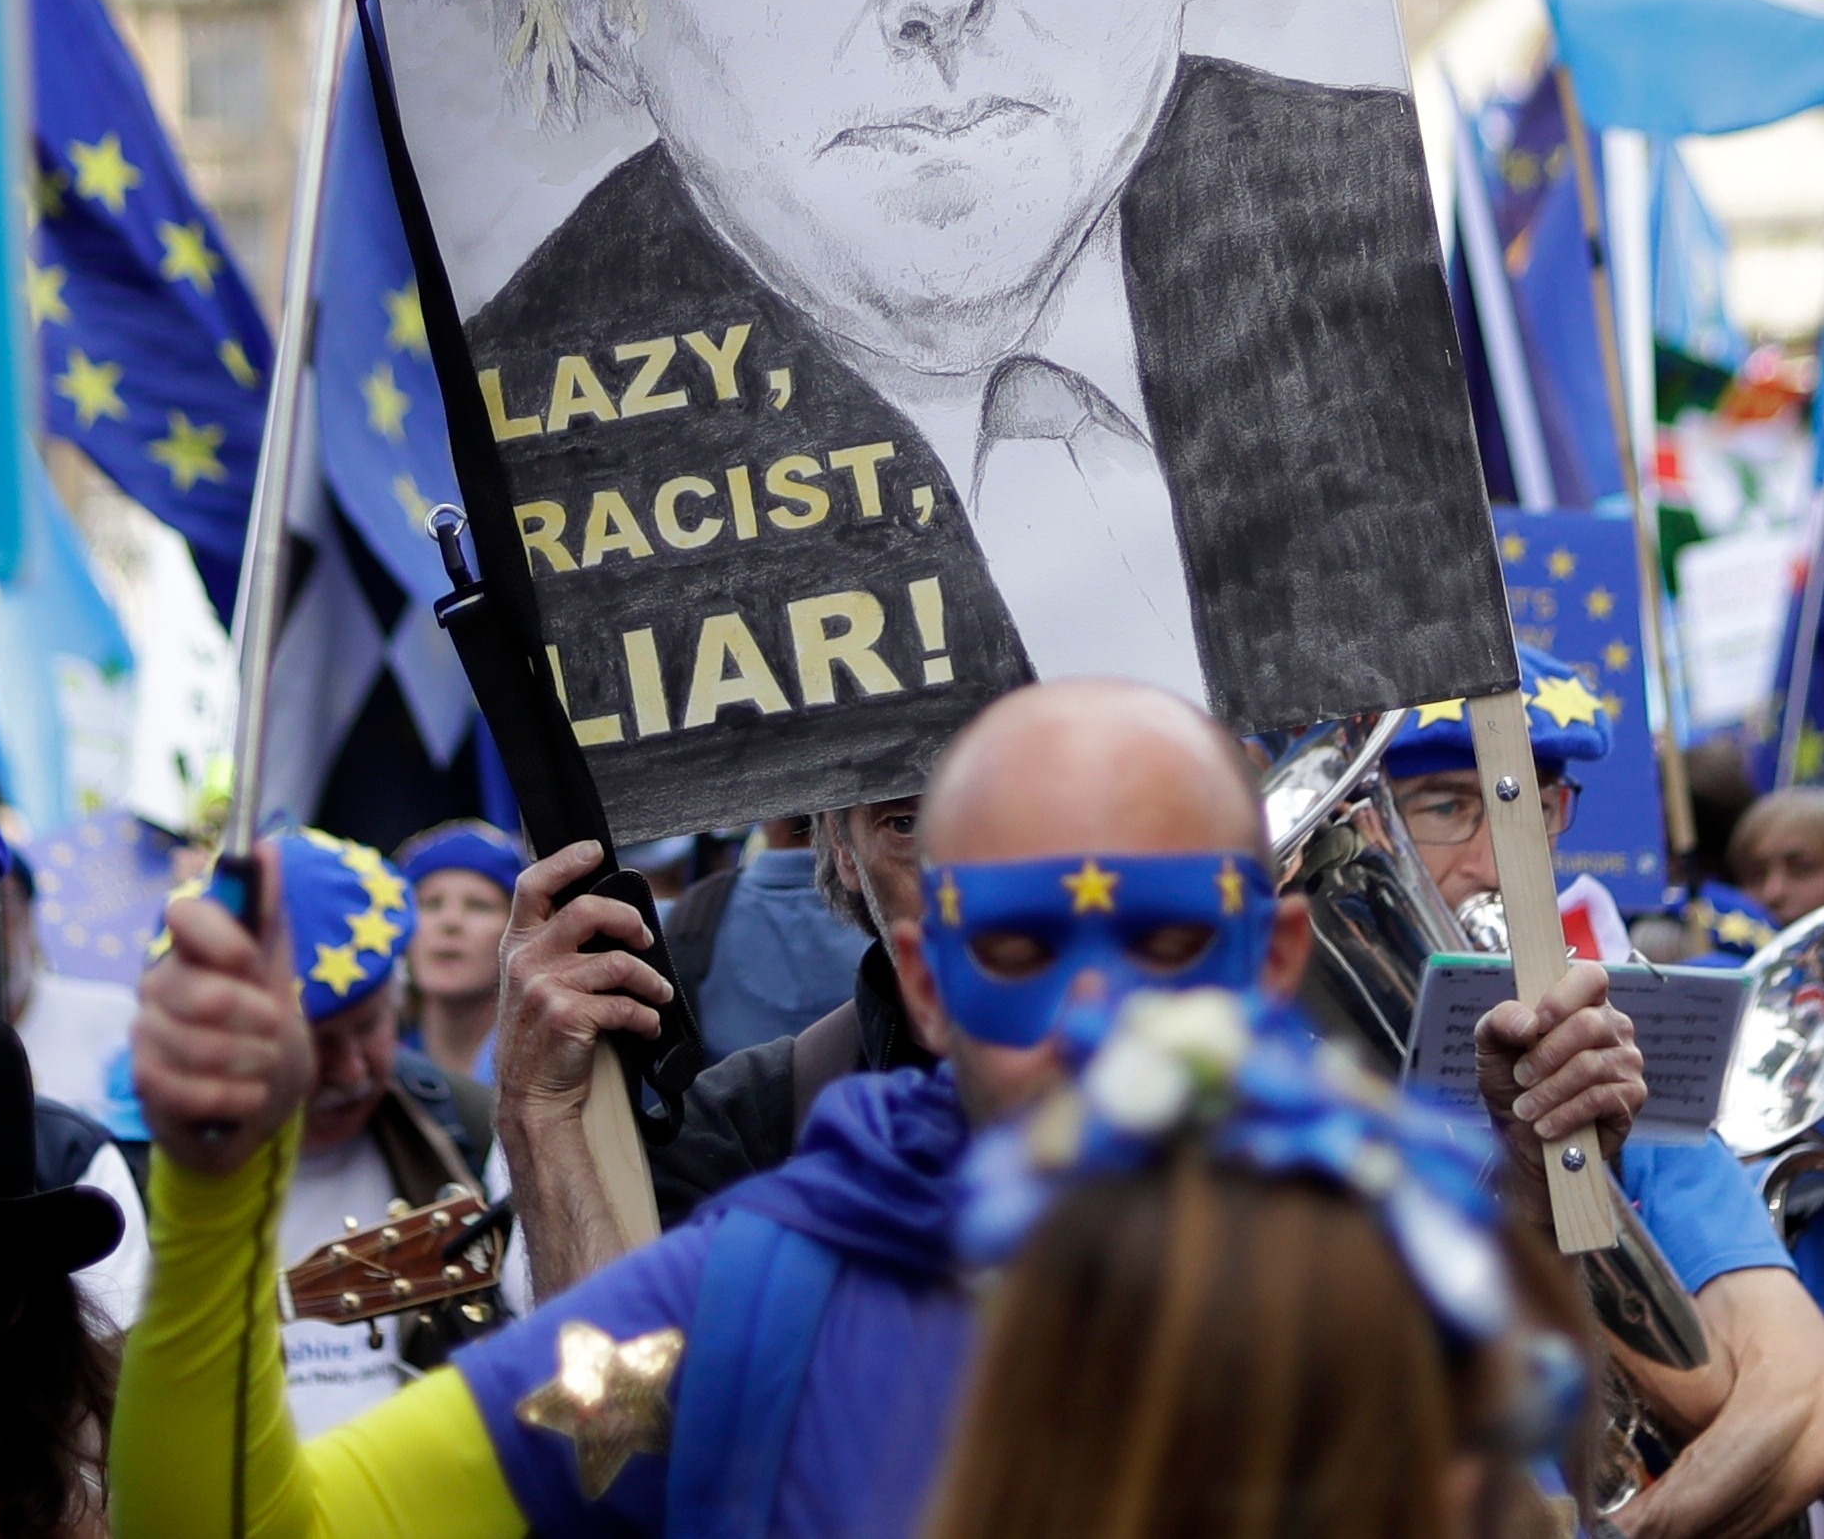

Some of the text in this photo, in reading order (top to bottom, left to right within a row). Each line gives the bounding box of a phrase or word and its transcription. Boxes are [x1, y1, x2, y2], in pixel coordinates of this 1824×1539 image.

[477, 323, 793, 443] LAZY,
[513, 441, 936, 578] RACIST,
[544, 575, 955, 748] LIAR!
